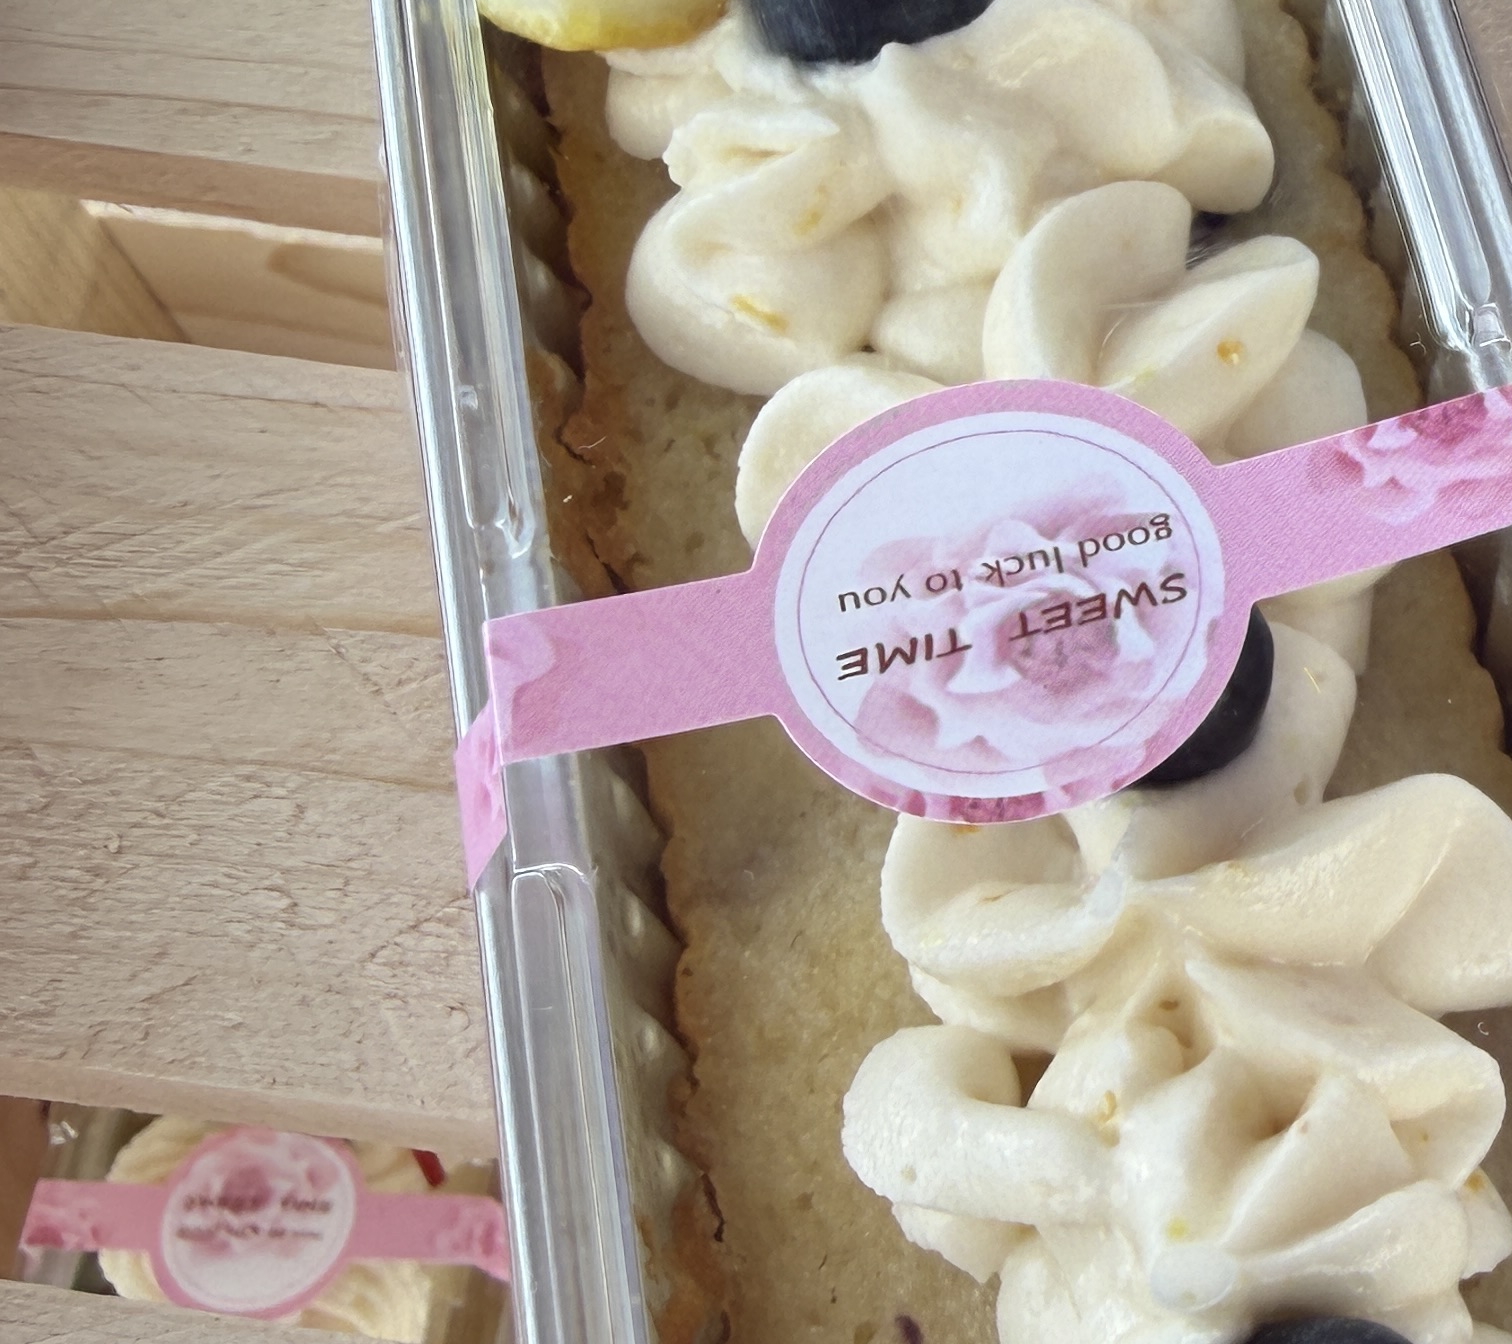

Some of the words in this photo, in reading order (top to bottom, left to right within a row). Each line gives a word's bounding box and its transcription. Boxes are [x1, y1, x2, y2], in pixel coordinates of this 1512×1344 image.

[1077, 512, 1174, 570] good
[925, 568, 964, 593] to
[981, 545, 1065, 587] luck
[837, 573, 917, 613] you
[1008, 572, 1189, 642] SWEET
[834, 626, 973, 681] TIME
